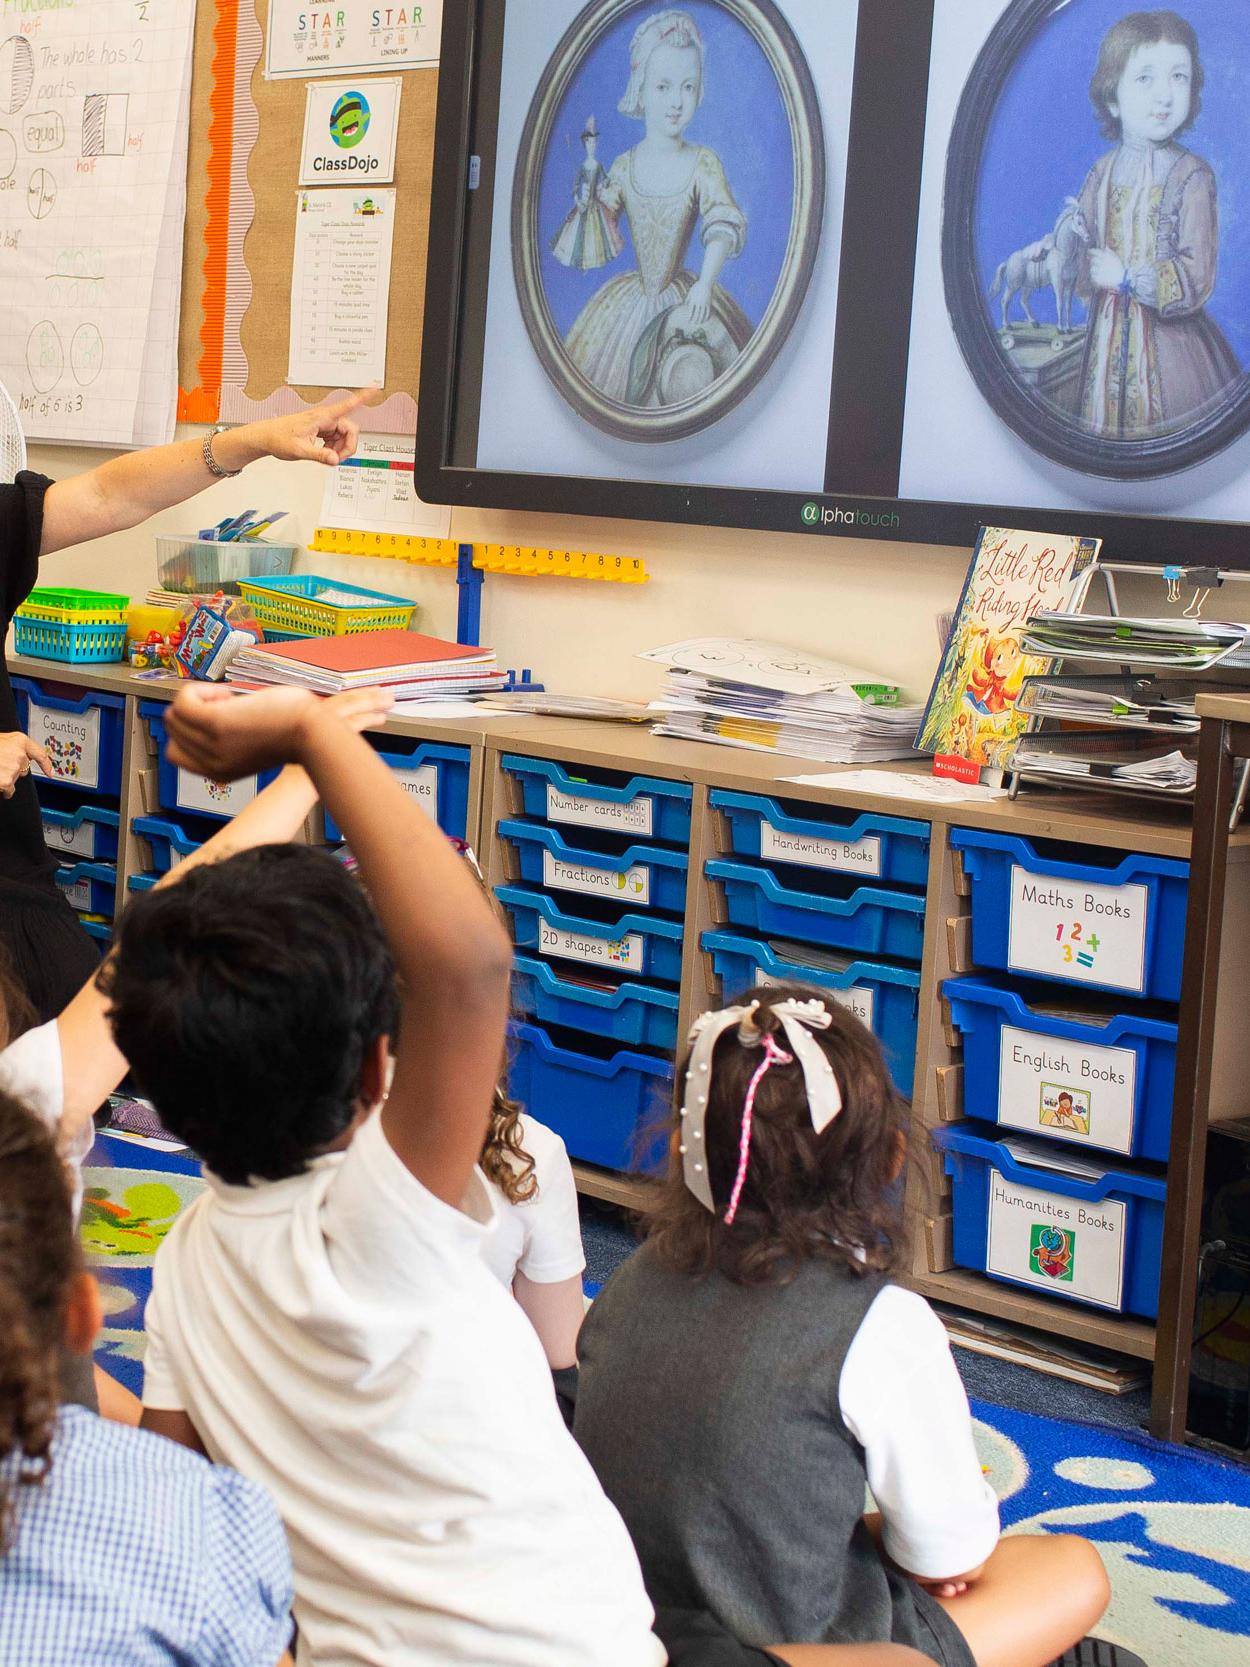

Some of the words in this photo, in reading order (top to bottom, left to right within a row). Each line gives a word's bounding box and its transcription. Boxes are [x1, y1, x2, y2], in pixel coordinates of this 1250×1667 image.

[139, 6, 149, 22] 2
[20, 17, 42, 36] half
[40, 46, 59, 67] The
[63, 42, 94, 65] whole
[101, 42, 128, 63] has
[133, 39, 143, 62] 2
[36, 77, 76, 110] parts
[27, 118, 59, 150] equal
[127, 132, 144, 152] half
[76, 159, 97, 174] half
[313, 155, 379, 173] ClassDojo
[3, 230, 21, 251] half
[20, 393, 37, 419] half
[40, 397, 51, 416] of
[54, 398, 62, 412] 6
[64, 395, 73, 412] is
[75, 394, 83, 412] 3
[363, 443, 378, 452] Tiger
[379, 444, 394, 453] Class
[317, 530, 323, 539] 10
[332, 531, 337, 540] 9
[347, 532, 351, 541] 8
[361, 533, 366, 542] 7
[376, 535, 380, 544] 6
[391, 536, 396, 545] 5
[406, 538, 410, 546] 4
[421, 539, 426, 548] 3
[436, 540, 442, 550] 2
[499, 546, 505, 556] 2
[515, 547, 521, 557] 3
[532, 550, 537, 558] 4
[548, 551, 553, 560] 5
[565, 552, 570, 562] 6
[582, 554, 587, 563] 7
[598, 555, 604, 565] 8
[615, 557, 621, 567] 9
[633, 559, 639, 569] 10
[980, 539, 1032, 586] Little
[1029, 549, 1072, 593] Red
[975, 587, 1031, 633] Riding
[43, 715, 86, 741] Counting
[940, 762, 975, 776] SCHOLASTIC
[400, 782, 431, 795] ames
[549, 796, 589, 816] Number
[595, 803, 622, 819] cards
[772, 834, 838, 861] Handwriting
[842, 845, 874, 864] Books
[553, 862, 610, 887] Fractions
[1022, 884, 1073, 909] Maths
[1084, 894, 1130, 918] Books
[543, 930, 558, 945] 2D
[564, 937, 603, 956] shapes
[1056, 923, 1064, 941] 1
[1071, 923, 1082, 941] 2
[1062, 944, 1073, 962] 3
[1013, 1045, 1070, 1073] English
[1081, 1059, 1125, 1084] Books
[994, 1187, 1071, 1222] Humanities
[1078, 1208, 1114, 1231] Books
